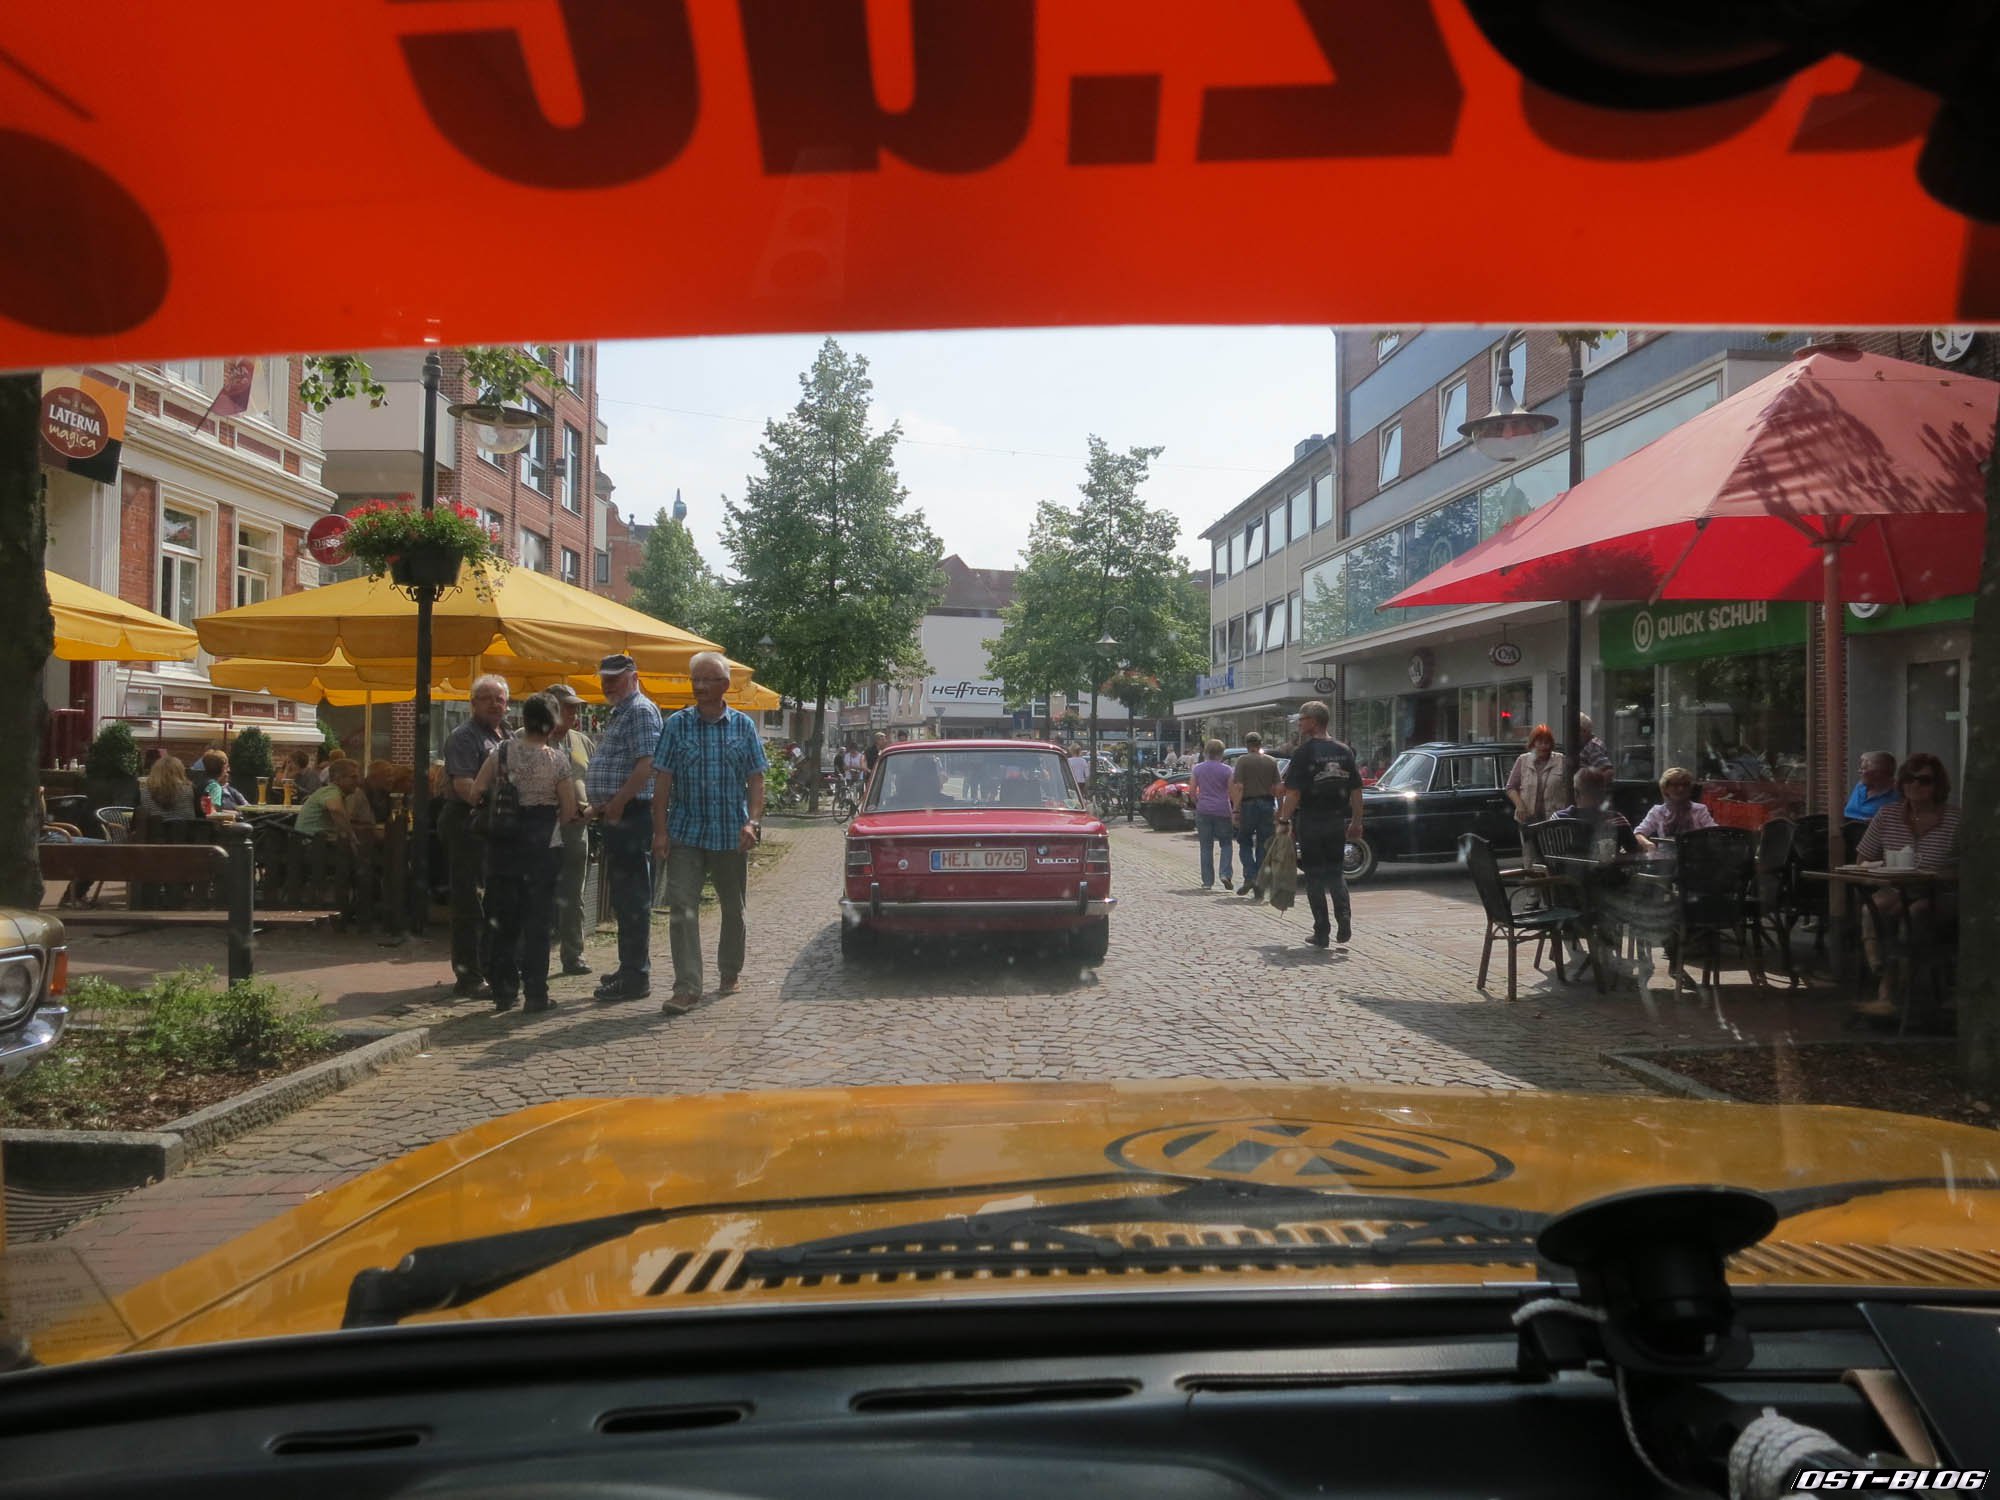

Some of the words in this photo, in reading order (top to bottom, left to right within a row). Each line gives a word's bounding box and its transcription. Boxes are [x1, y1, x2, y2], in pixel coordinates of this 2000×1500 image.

[49, 404, 101, 436] LATERNA
[48, 424, 97, 450] magica
[1657, 610, 1705, 640] QUICK
[1709, 600, 1768, 631] SCHUH
[942, 852, 971, 867] HEI
[984, 852, 1023, 867] 0765
